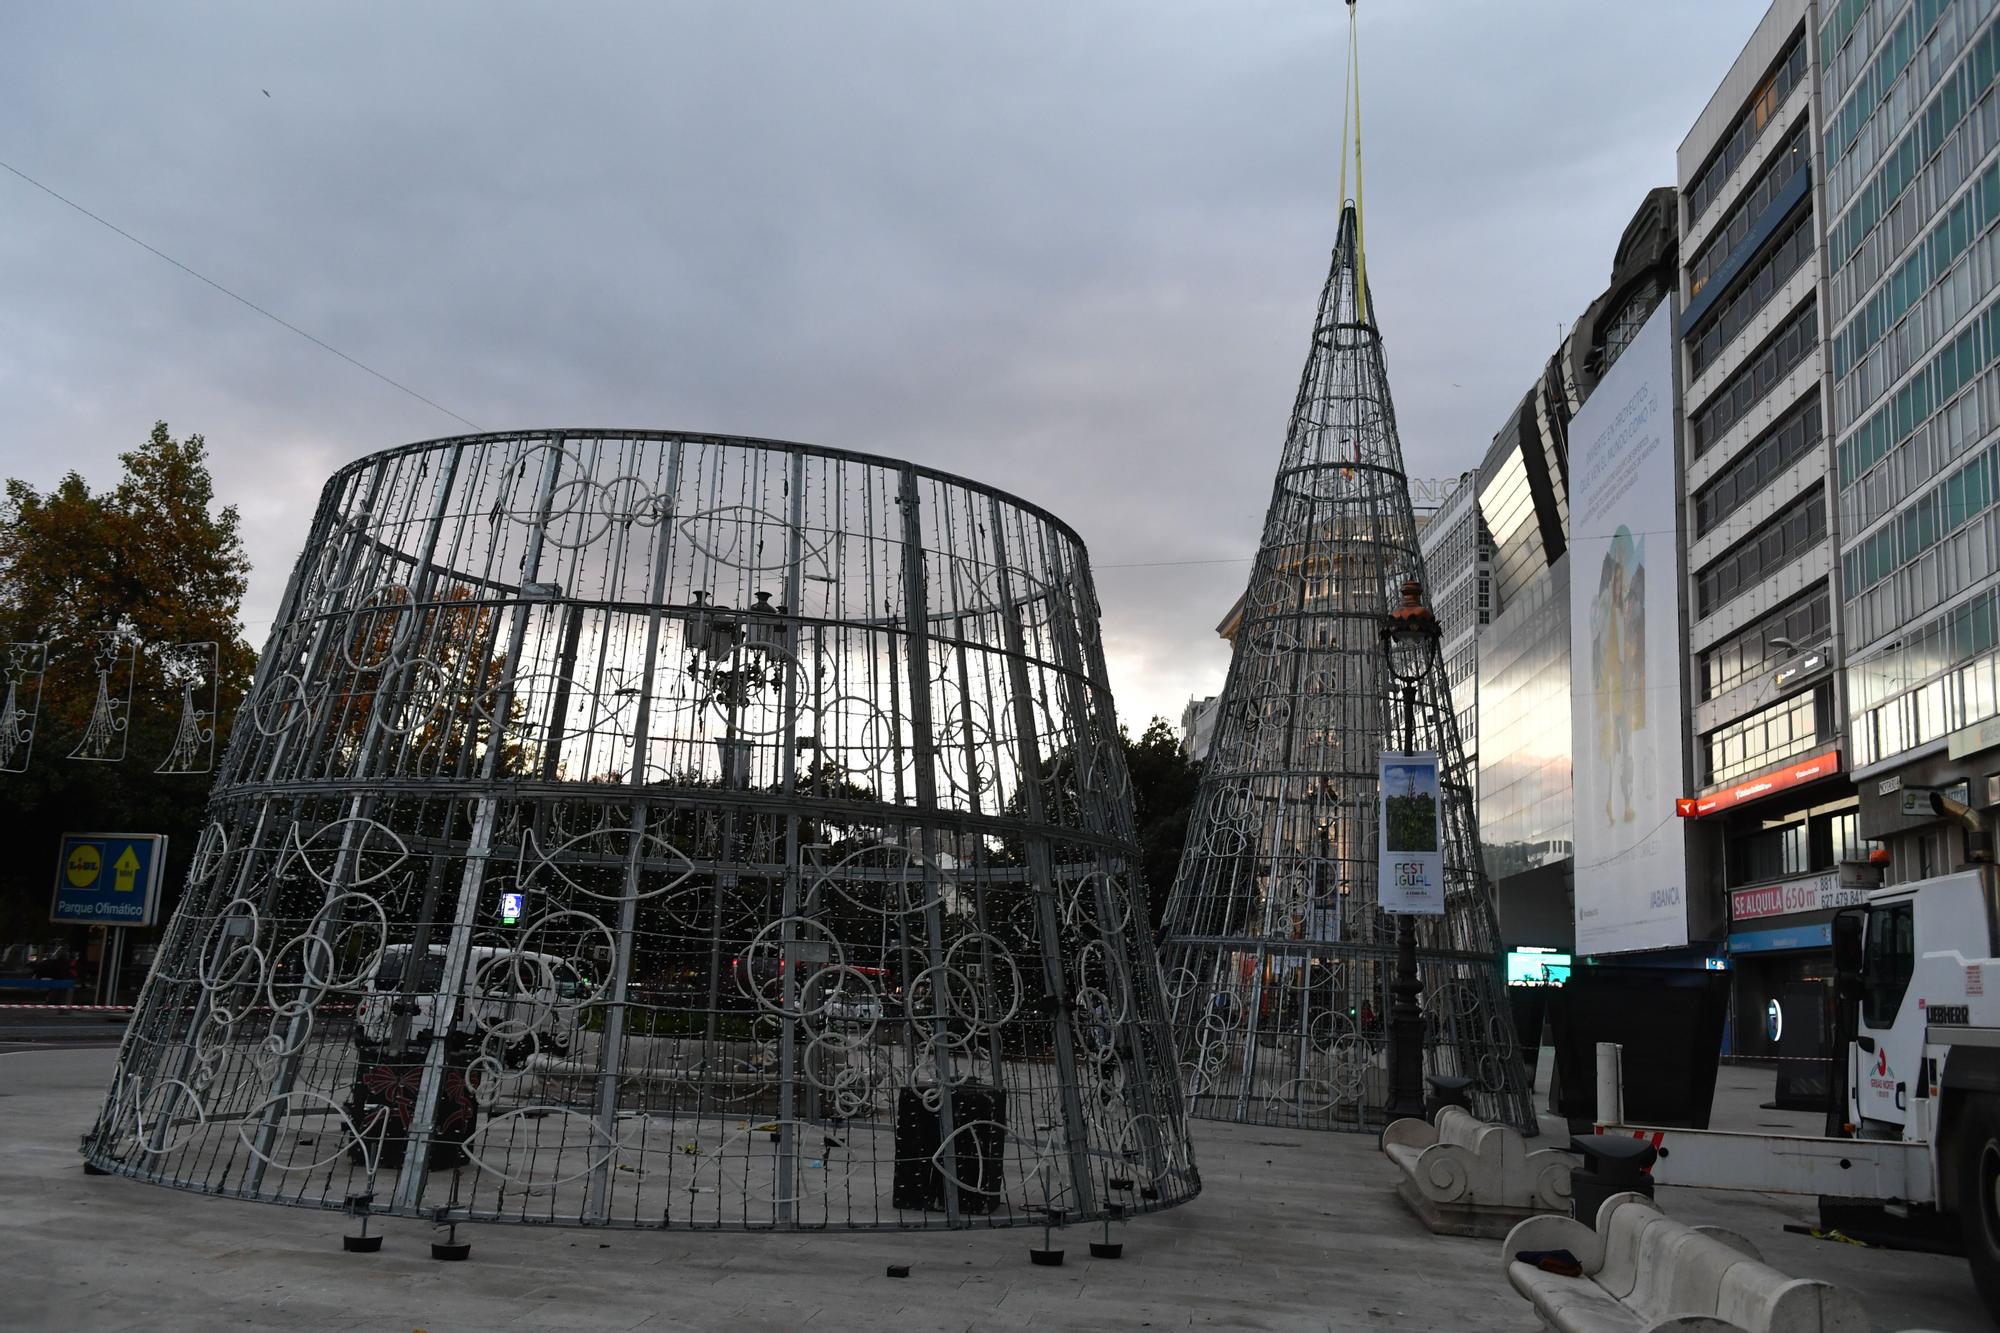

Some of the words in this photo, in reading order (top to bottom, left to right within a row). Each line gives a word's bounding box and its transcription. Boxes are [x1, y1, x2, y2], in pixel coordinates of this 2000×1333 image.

[1395, 863, 1425, 874] FEST
[1395, 875, 1432, 887] IGUAL
[1735, 896, 1744, 914] SE
[1746, 890, 1782, 914] ALQUILA
[1786, 887, 1804, 909] 650
[1821, 893, 1833, 908] 627
[1835, 891, 1848, 906] 479
[1850, 889, 1863, 904] 841
[58, 901, 93, 915] Parque
[95, 902, 143, 915] Ofimático
[1927, 1006, 1968, 1024] LIEBHERR
